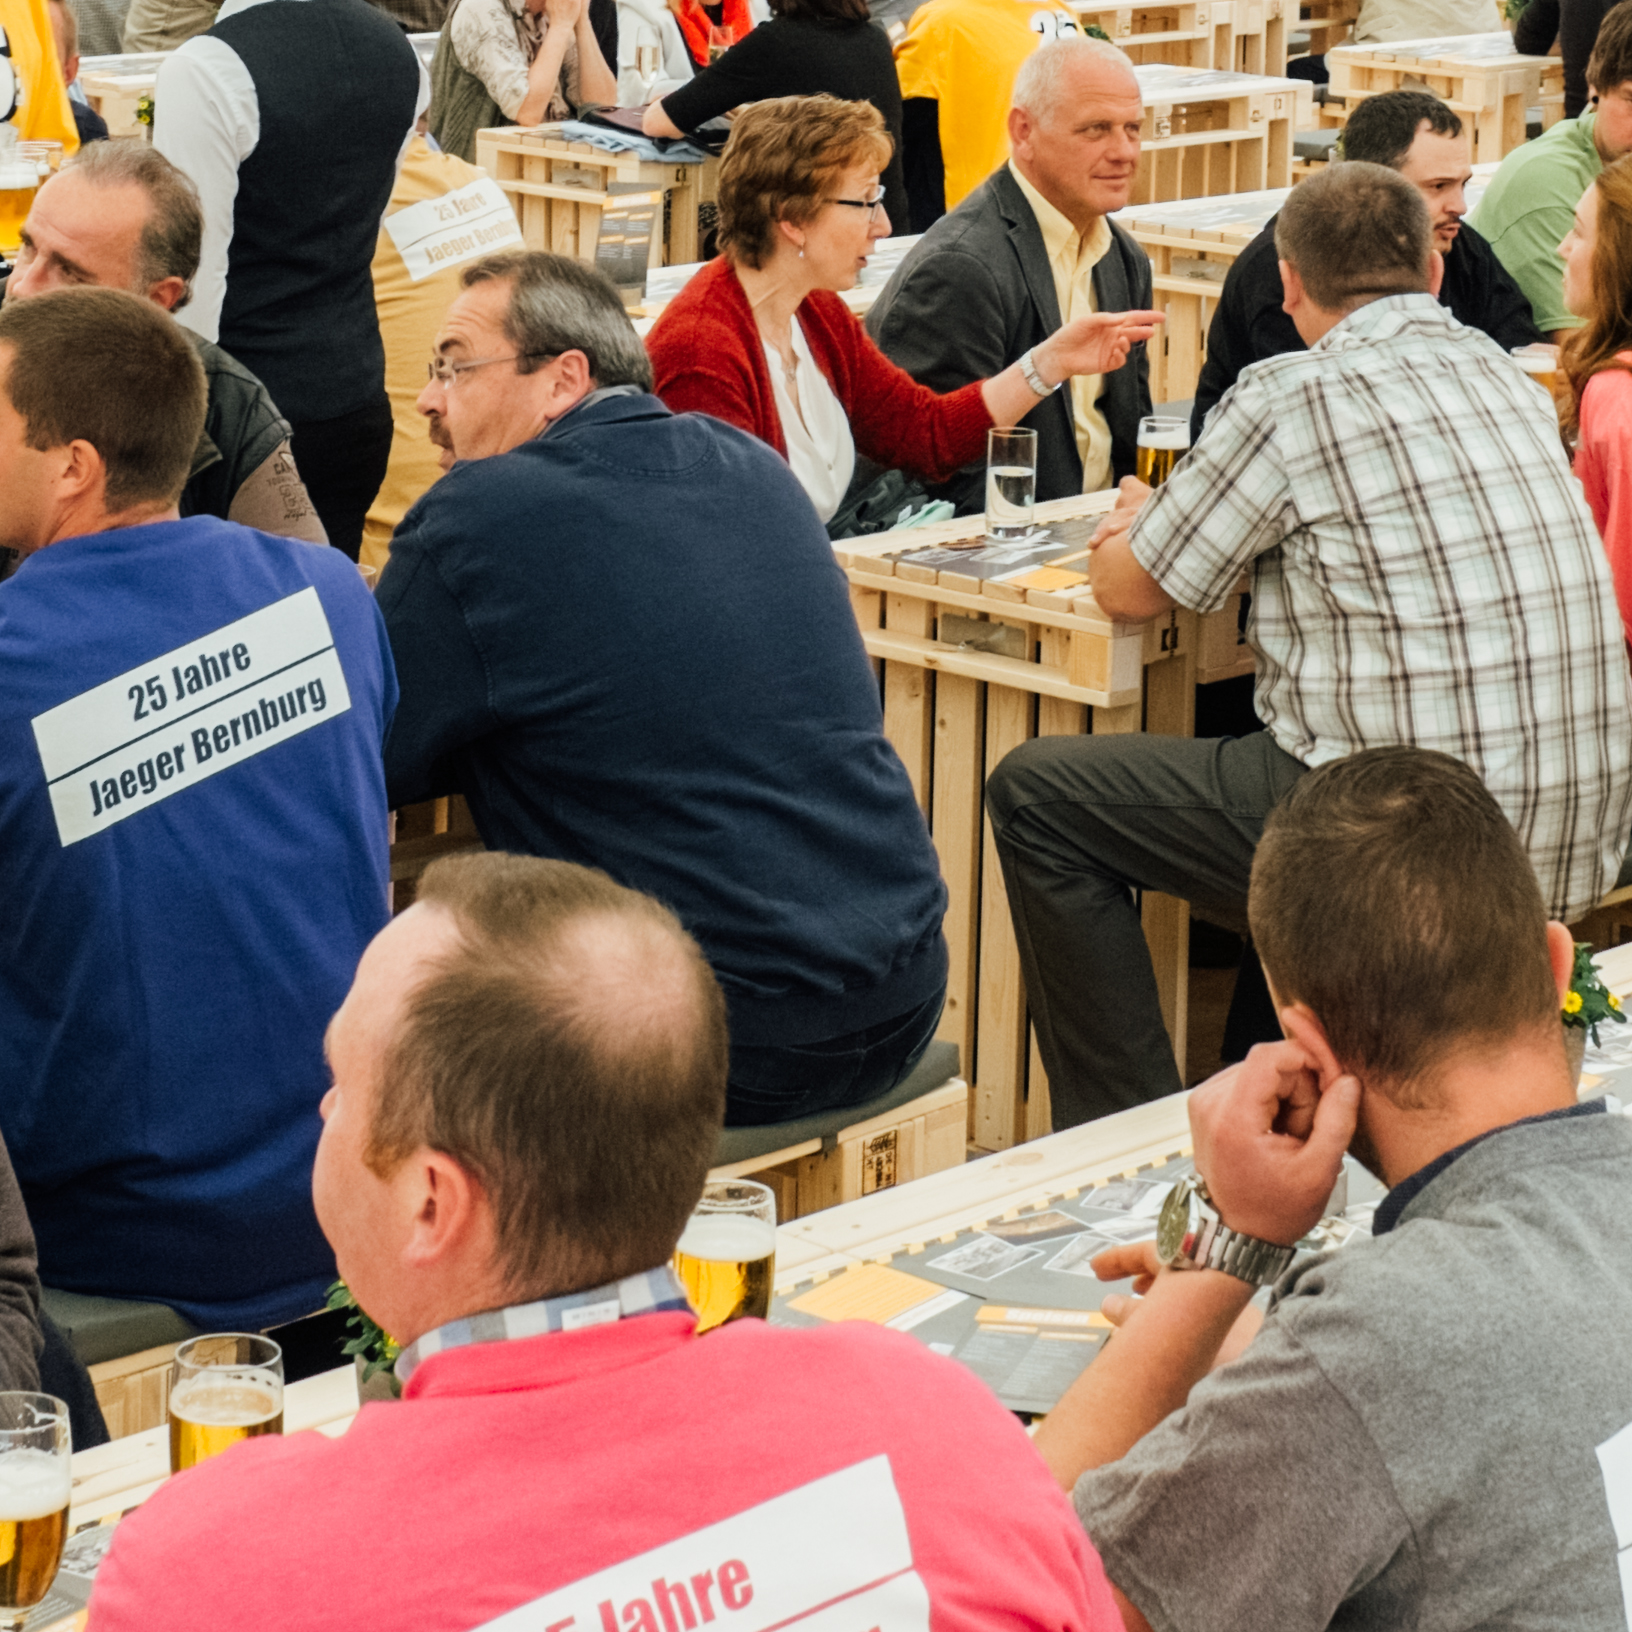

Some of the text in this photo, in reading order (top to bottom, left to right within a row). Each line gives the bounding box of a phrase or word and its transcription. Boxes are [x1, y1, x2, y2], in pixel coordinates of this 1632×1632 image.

[424, 237, 475, 265] Jaeger
[128, 642, 250, 722] 25 Jahre
[88, 678, 327, 817] Jaeger Bernburg
[597, 1558, 755, 1632] Jahre
